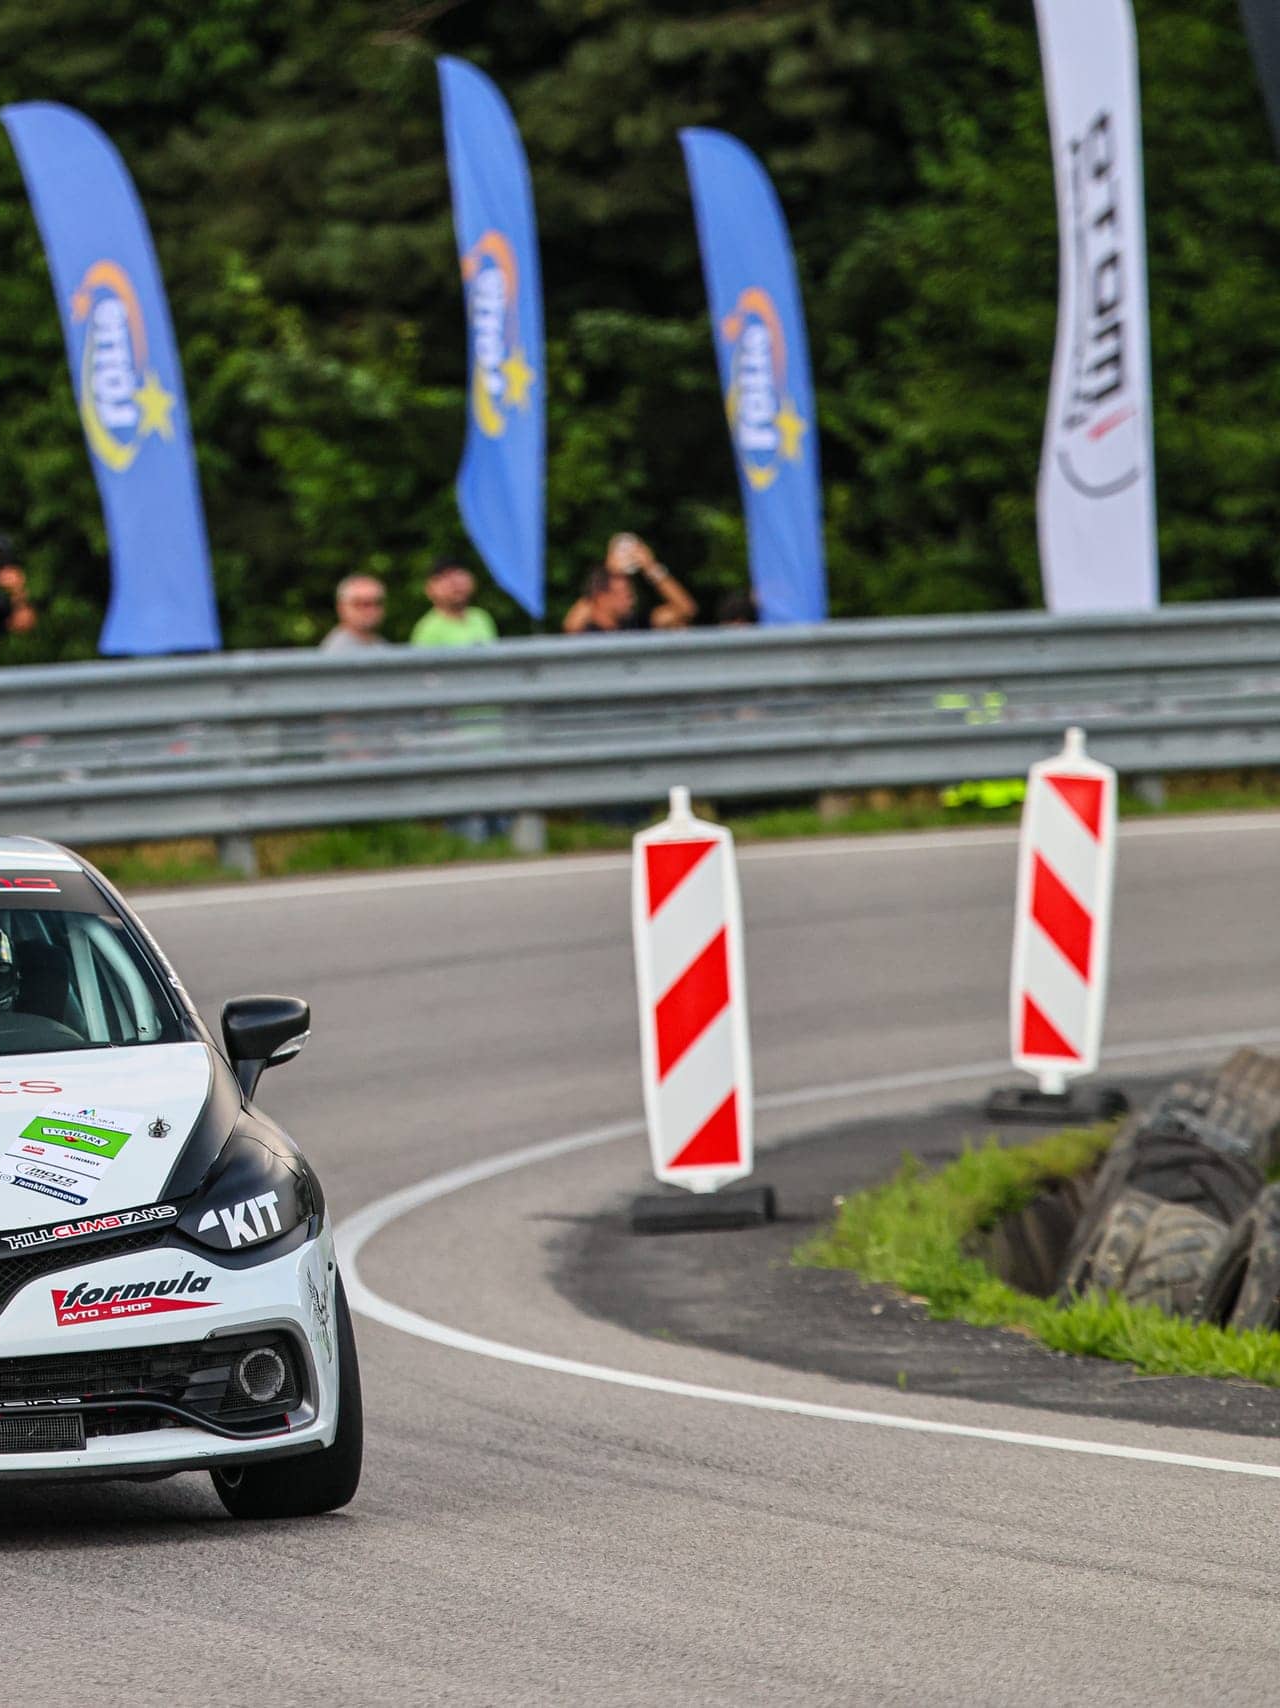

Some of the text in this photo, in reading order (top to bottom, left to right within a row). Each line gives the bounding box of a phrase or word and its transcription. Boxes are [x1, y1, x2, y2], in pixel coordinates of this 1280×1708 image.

[219, 1190, 279, 1248] KIT
[63, 1271, 212, 1308] formula
[111, 1303, 152, 1316] SHOP
